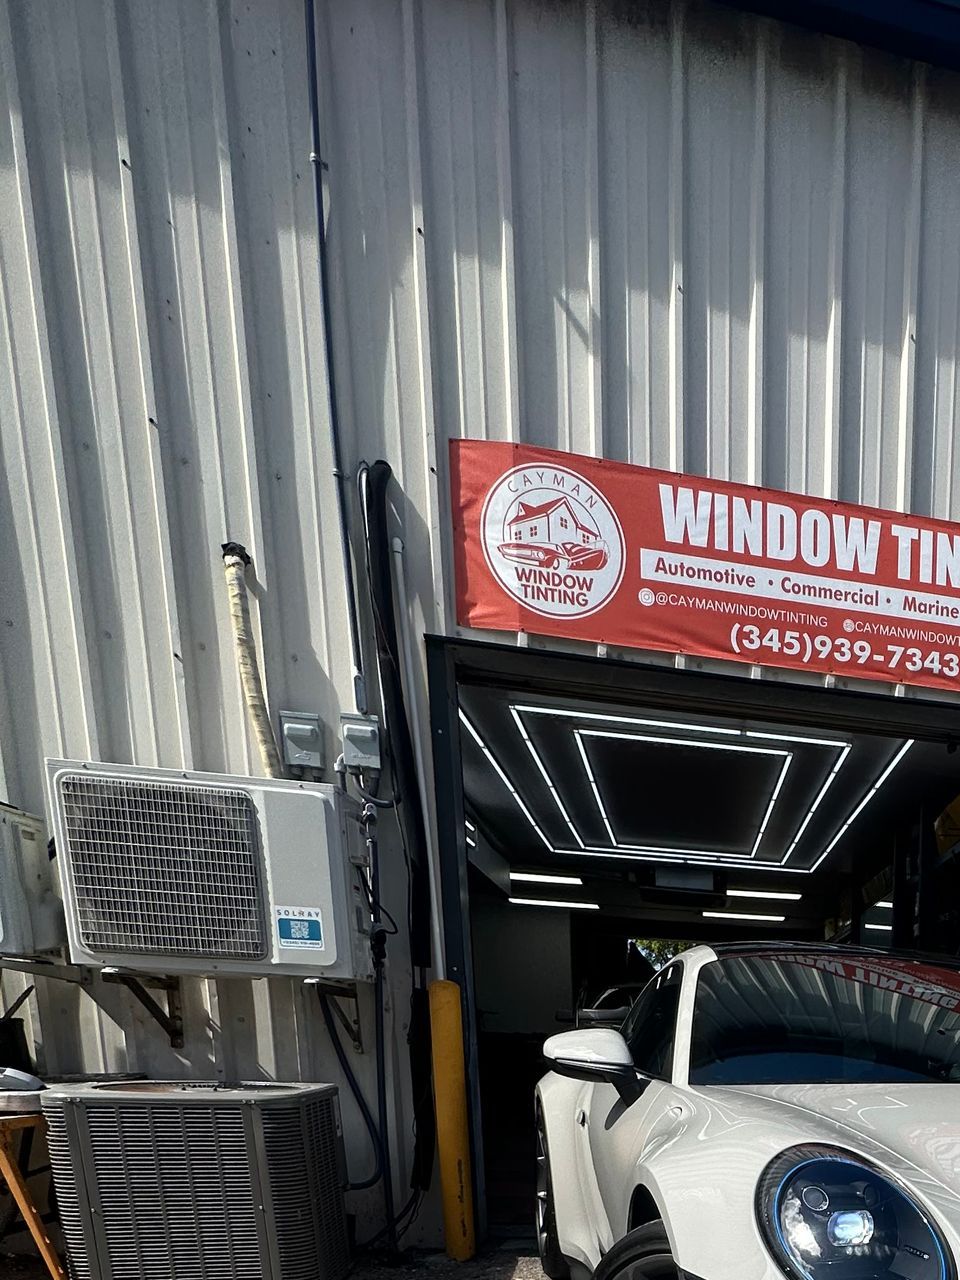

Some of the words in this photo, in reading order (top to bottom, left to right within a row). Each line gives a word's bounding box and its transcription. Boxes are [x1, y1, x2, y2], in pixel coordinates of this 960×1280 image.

[508, 472, 597, 508] CAYMAN
[658, 483, 881, 575] WINDOW
[514, 566, 593, 592] WINDOW
[520, 584, 588, 607] TINTING
[655, 557, 756, 587] Automotive
[781, 577, 879, 606] Commercial
[903, 596, 959, 619] Marine
[656, 592, 828, 628] @CAYMANWINDOWTINTING
[730, 622, 960, 677] (345)939-7343
[276, 909, 320, 918] SOLRAY
